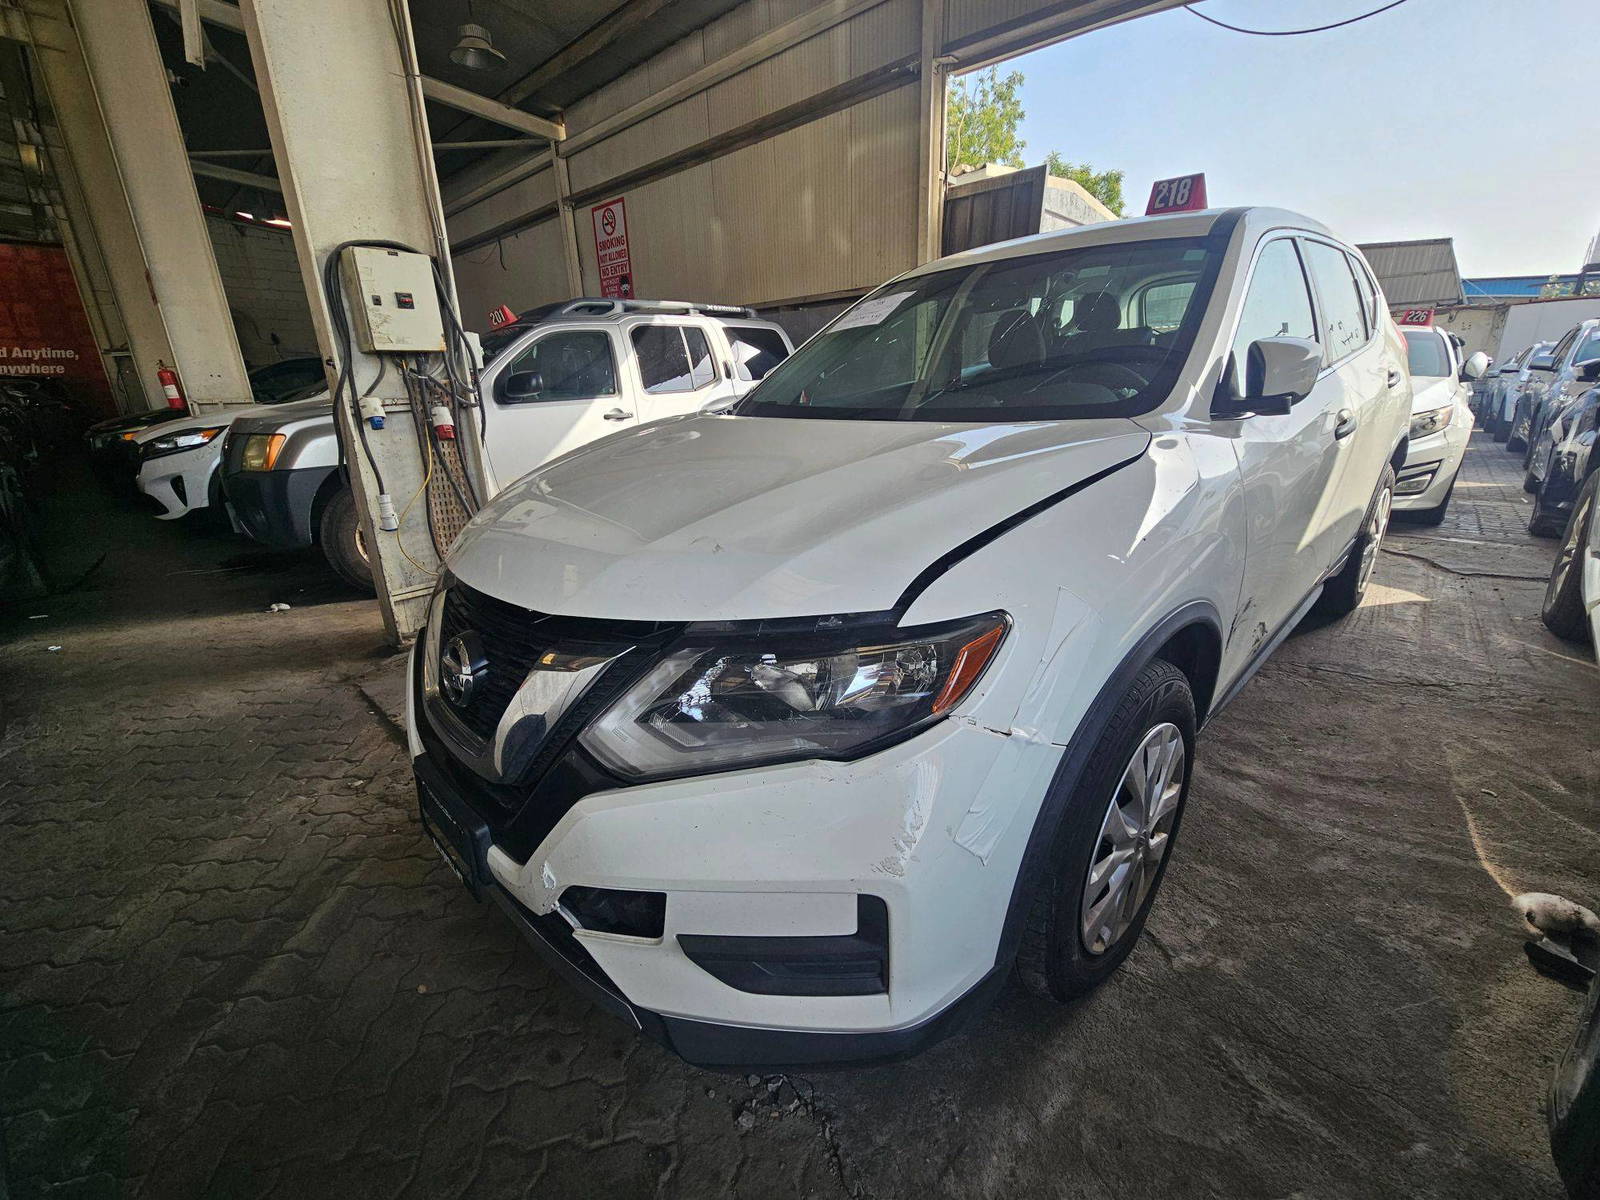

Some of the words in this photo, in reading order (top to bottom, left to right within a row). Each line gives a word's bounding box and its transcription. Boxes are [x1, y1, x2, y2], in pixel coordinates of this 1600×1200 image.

[1154, 178, 1192, 208] 218
[599, 235, 625, 252] SMOKING
[600, 252, 608, 265] NOT
[608, 248, 627, 262] ALLOWED
[601, 266, 610, 277] NO
[610, 262, 628, 275] ENTRY
[489, 309, 506, 326] 201
[1406, 310, 1428, 322] 226
[12, 347, 79, 360] Anytime,
